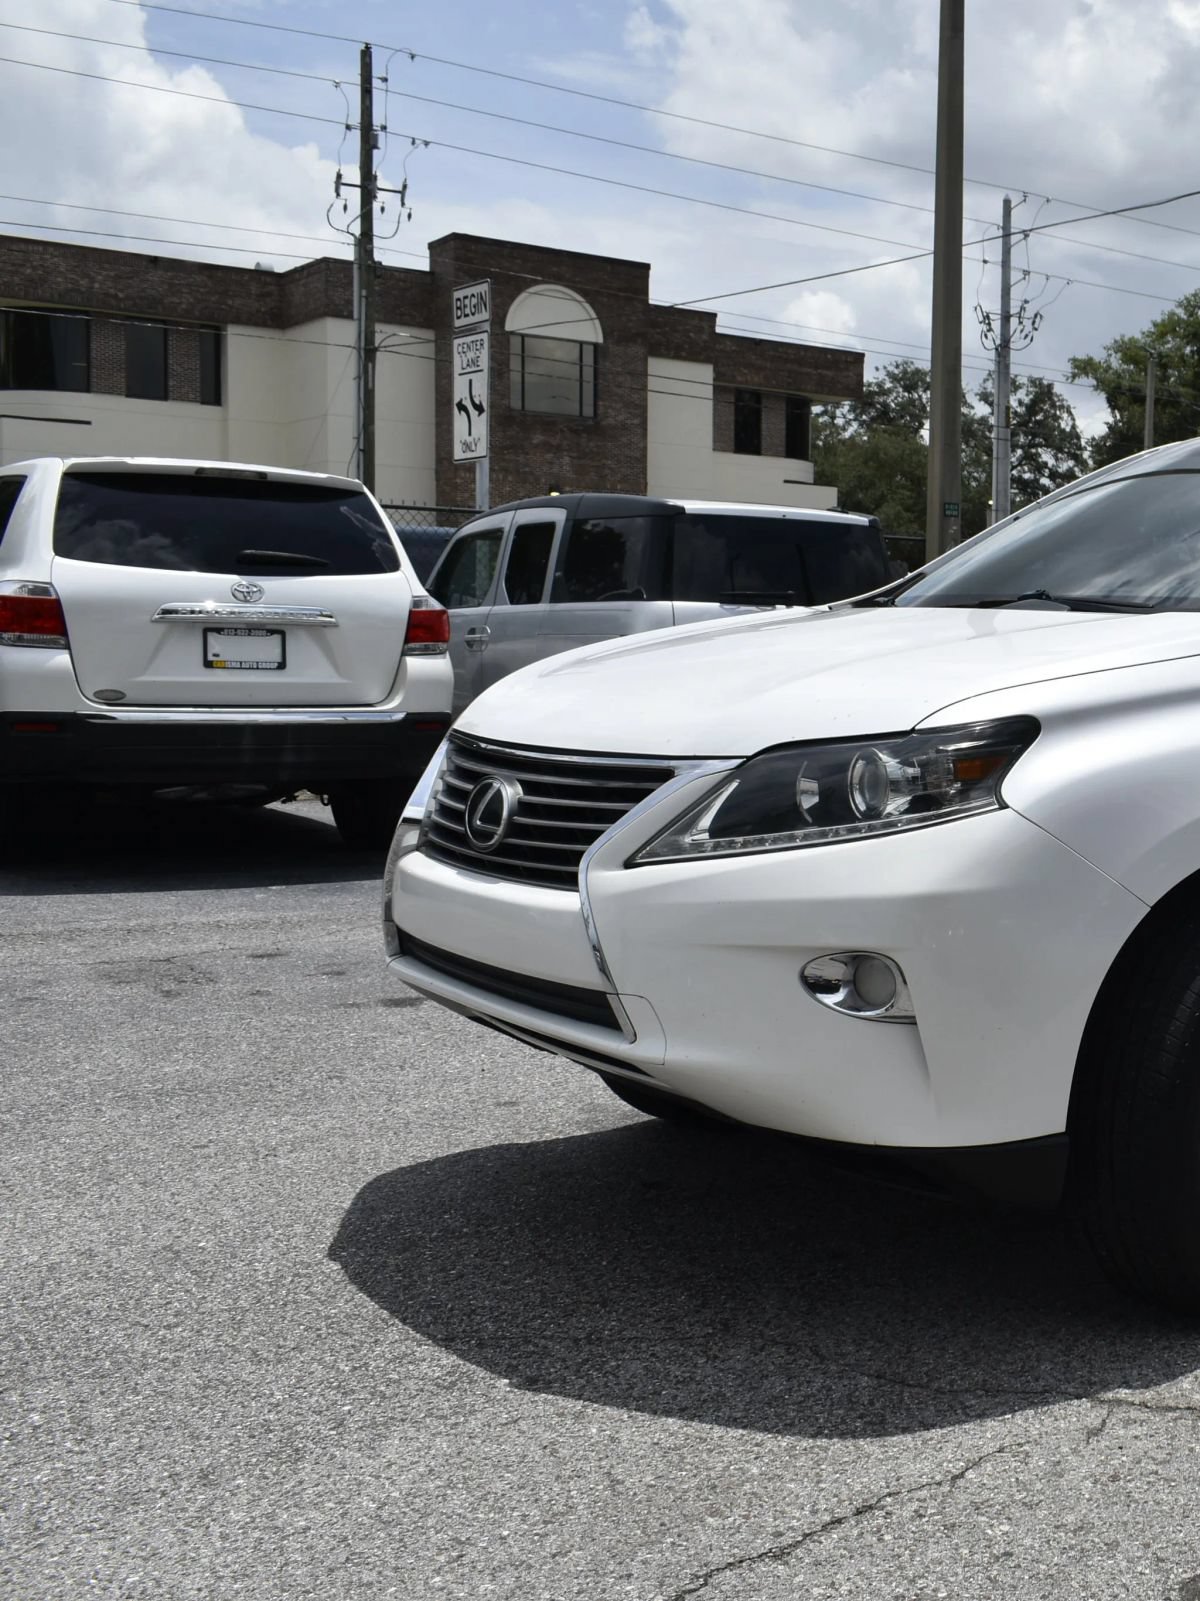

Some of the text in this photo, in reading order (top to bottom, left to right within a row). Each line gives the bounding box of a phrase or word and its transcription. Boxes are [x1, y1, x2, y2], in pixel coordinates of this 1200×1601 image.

[455, 289, 488, 320] BEGIN
[457, 338, 485, 355] CENTER
[461, 355, 481, 370] LANE
[241, 661, 257, 669] AUTO
